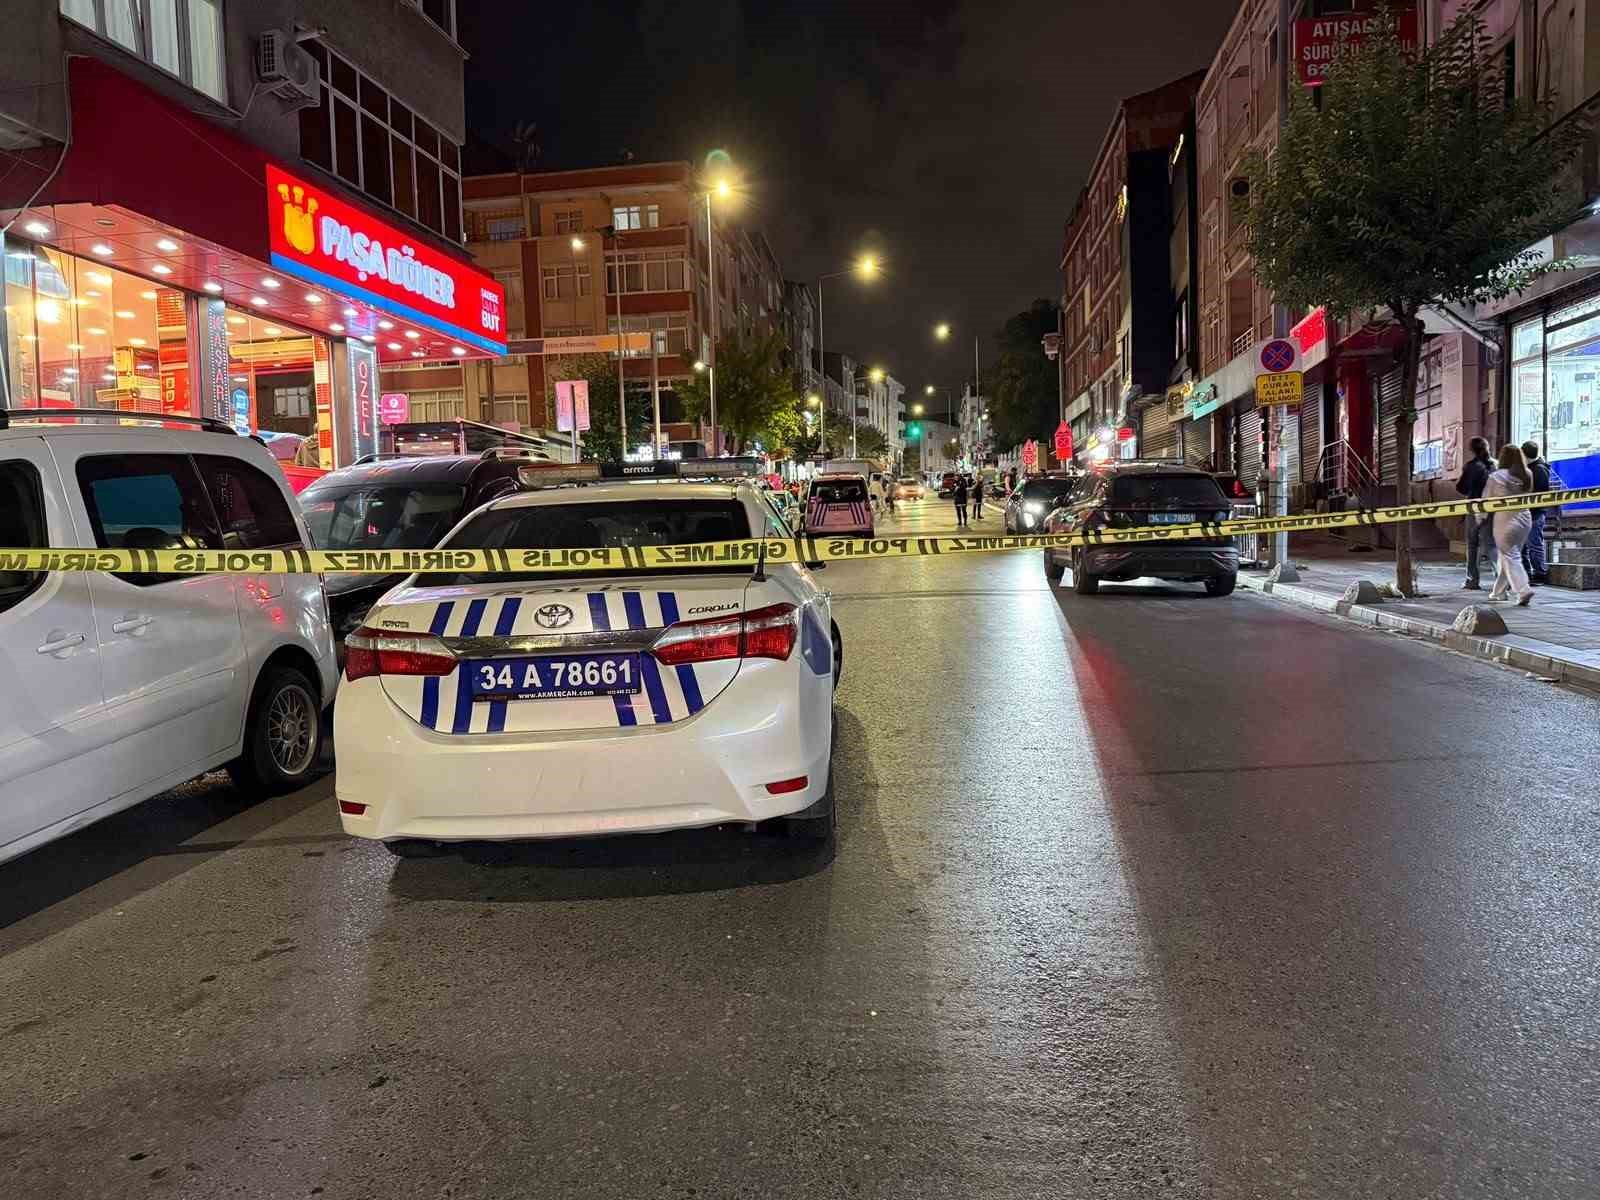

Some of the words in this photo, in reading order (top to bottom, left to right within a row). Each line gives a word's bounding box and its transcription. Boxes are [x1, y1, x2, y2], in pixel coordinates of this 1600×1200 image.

[320, 215, 389, 281] PAŞA
[386, 244, 456, 309] DÖNER
[481, 309, 500, 332] BUT
[688, 602, 739, 614] COROLLA
[480, 665, 514, 690] 34
[522, 663, 543, 688] A
[550, 659, 632, 687] 78661
